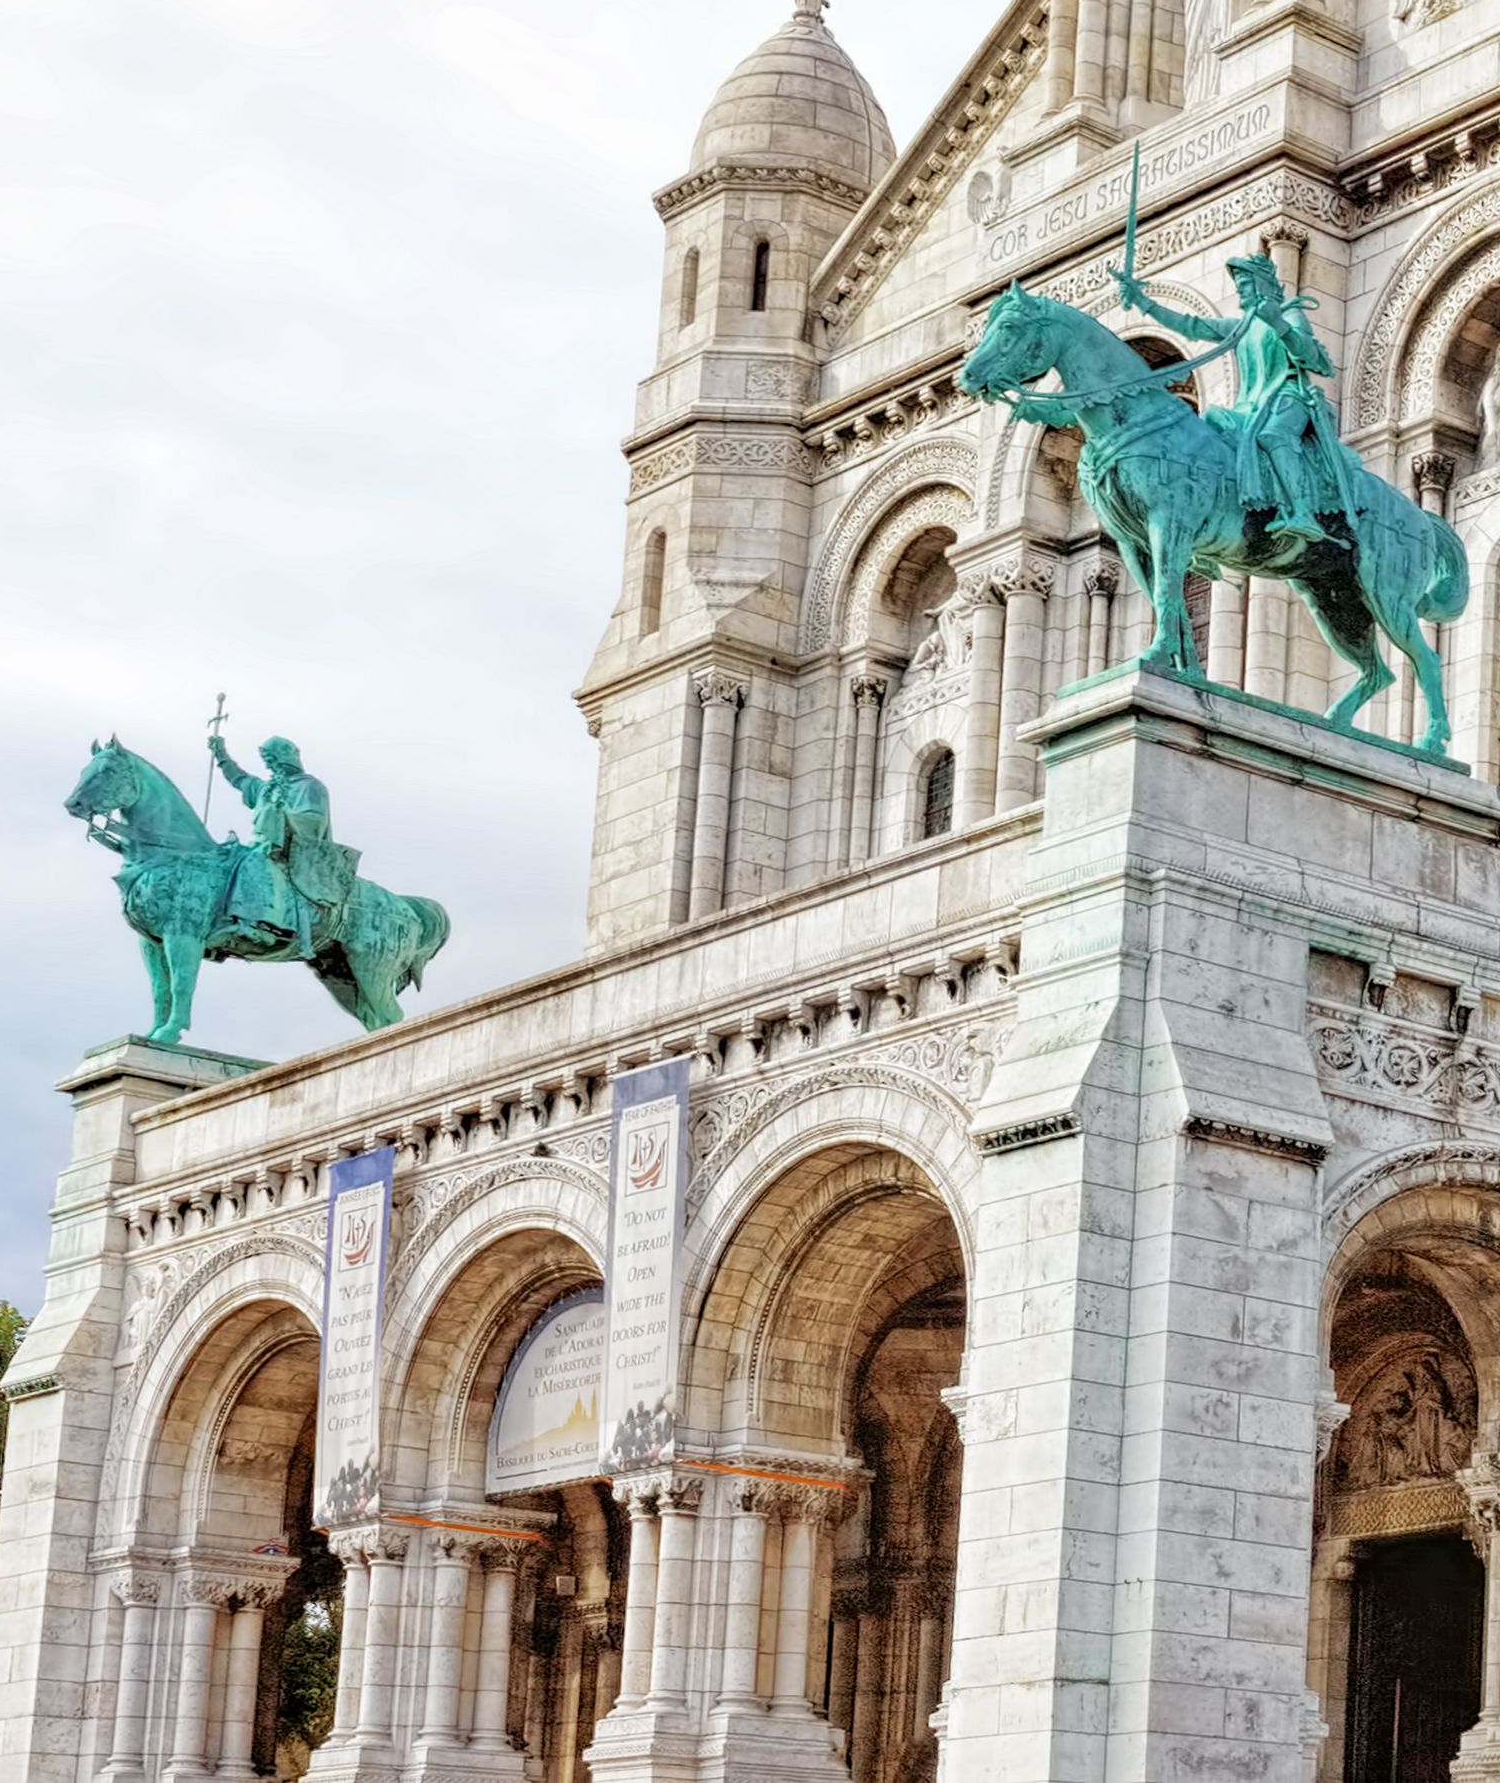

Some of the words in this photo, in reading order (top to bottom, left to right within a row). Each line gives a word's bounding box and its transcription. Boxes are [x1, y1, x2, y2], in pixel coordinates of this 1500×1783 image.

[990, 224, 1028, 262] COR
[1036, 193, 1088, 239] JESU
[644, 1207, 667, 1223] NOT
[631, 1231, 671, 1253] AFRAID!
[628, 1265, 656, 1283] OPEN
[616, 1297, 642, 1313] WIDE
[644, 1292, 666, 1308] THE
[612, 1324, 645, 1343] DOORS
[646, 1321, 667, 1335] FOR
